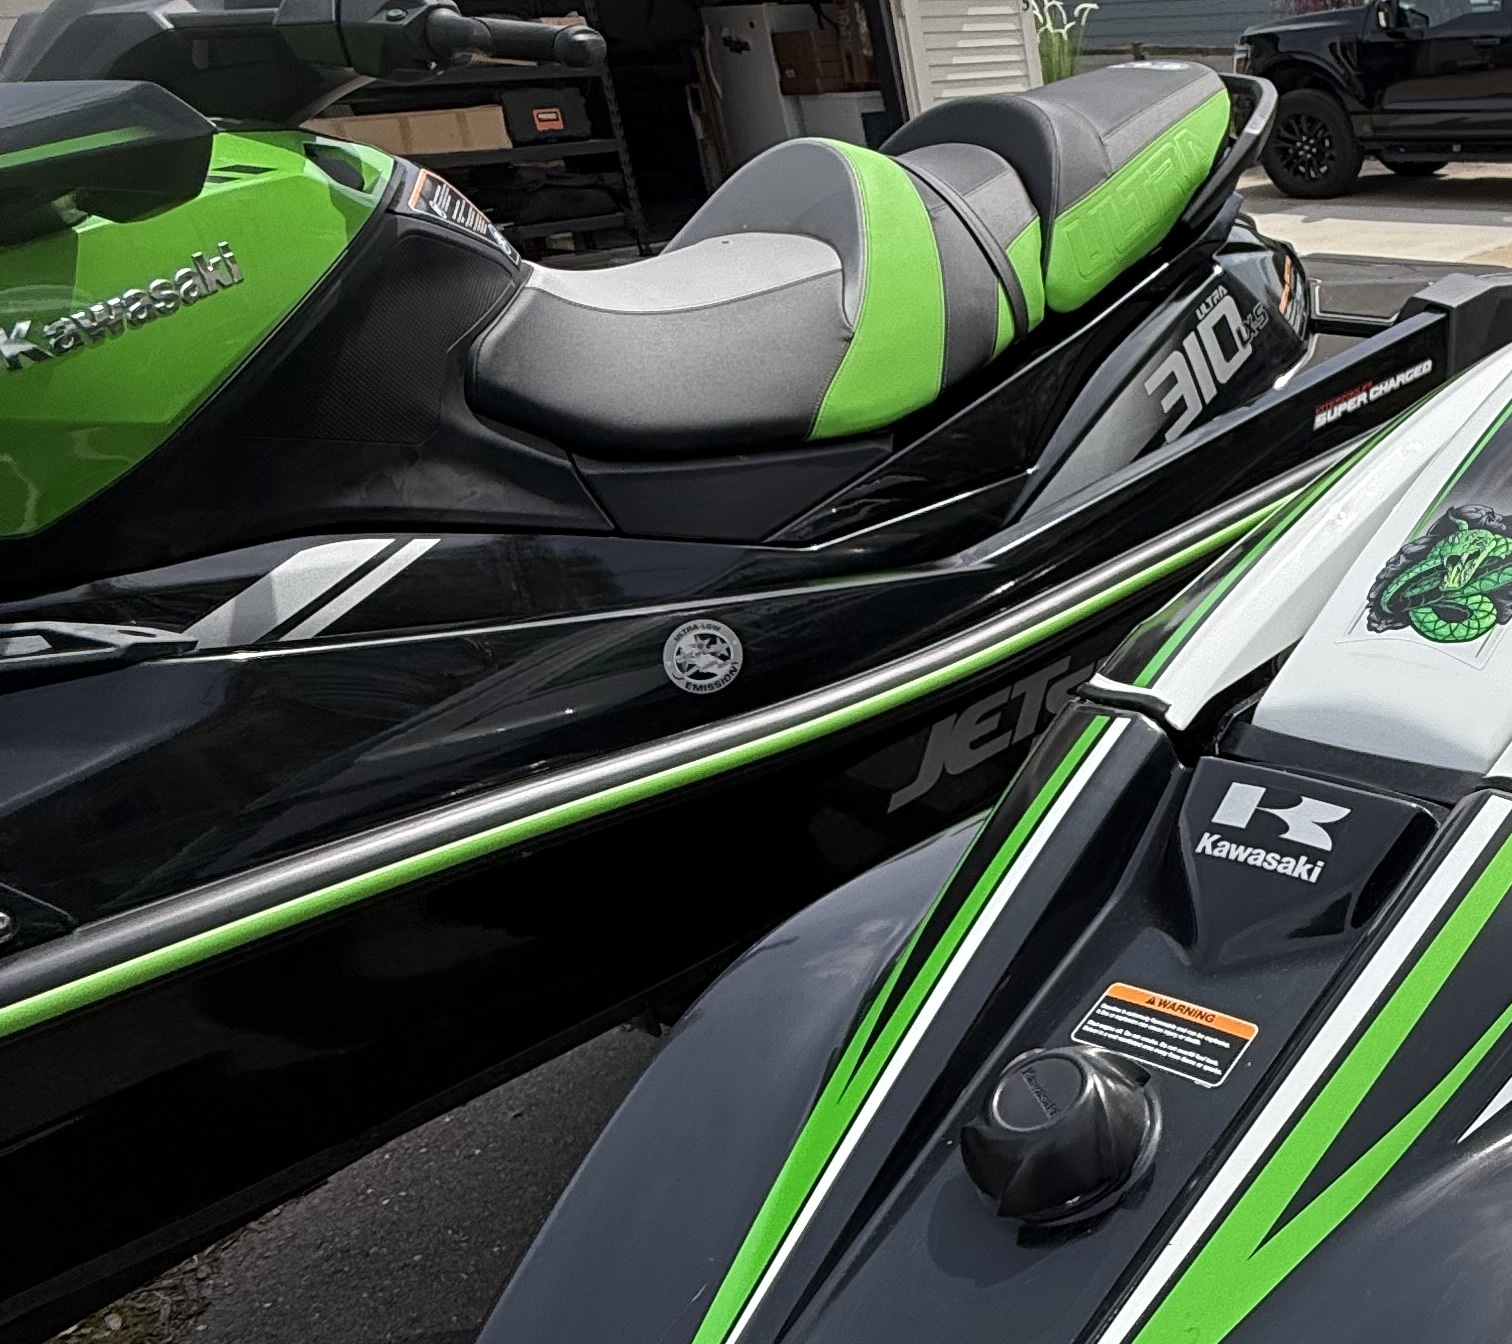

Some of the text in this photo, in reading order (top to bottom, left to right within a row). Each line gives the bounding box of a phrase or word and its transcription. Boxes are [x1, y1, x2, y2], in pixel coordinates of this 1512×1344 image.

[0, 240, 245, 370] Kawasaki
[1195, 284, 1229, 321] ULTRA
[1143, 295, 1253, 444] 310
[1313, 391, 1369, 431] SUPER
[1369, 358, 1433, 402] CHARGED
[1195, 831, 1325, 883] Kawasaki
[1157, 998, 1216, 1023] WARNING
